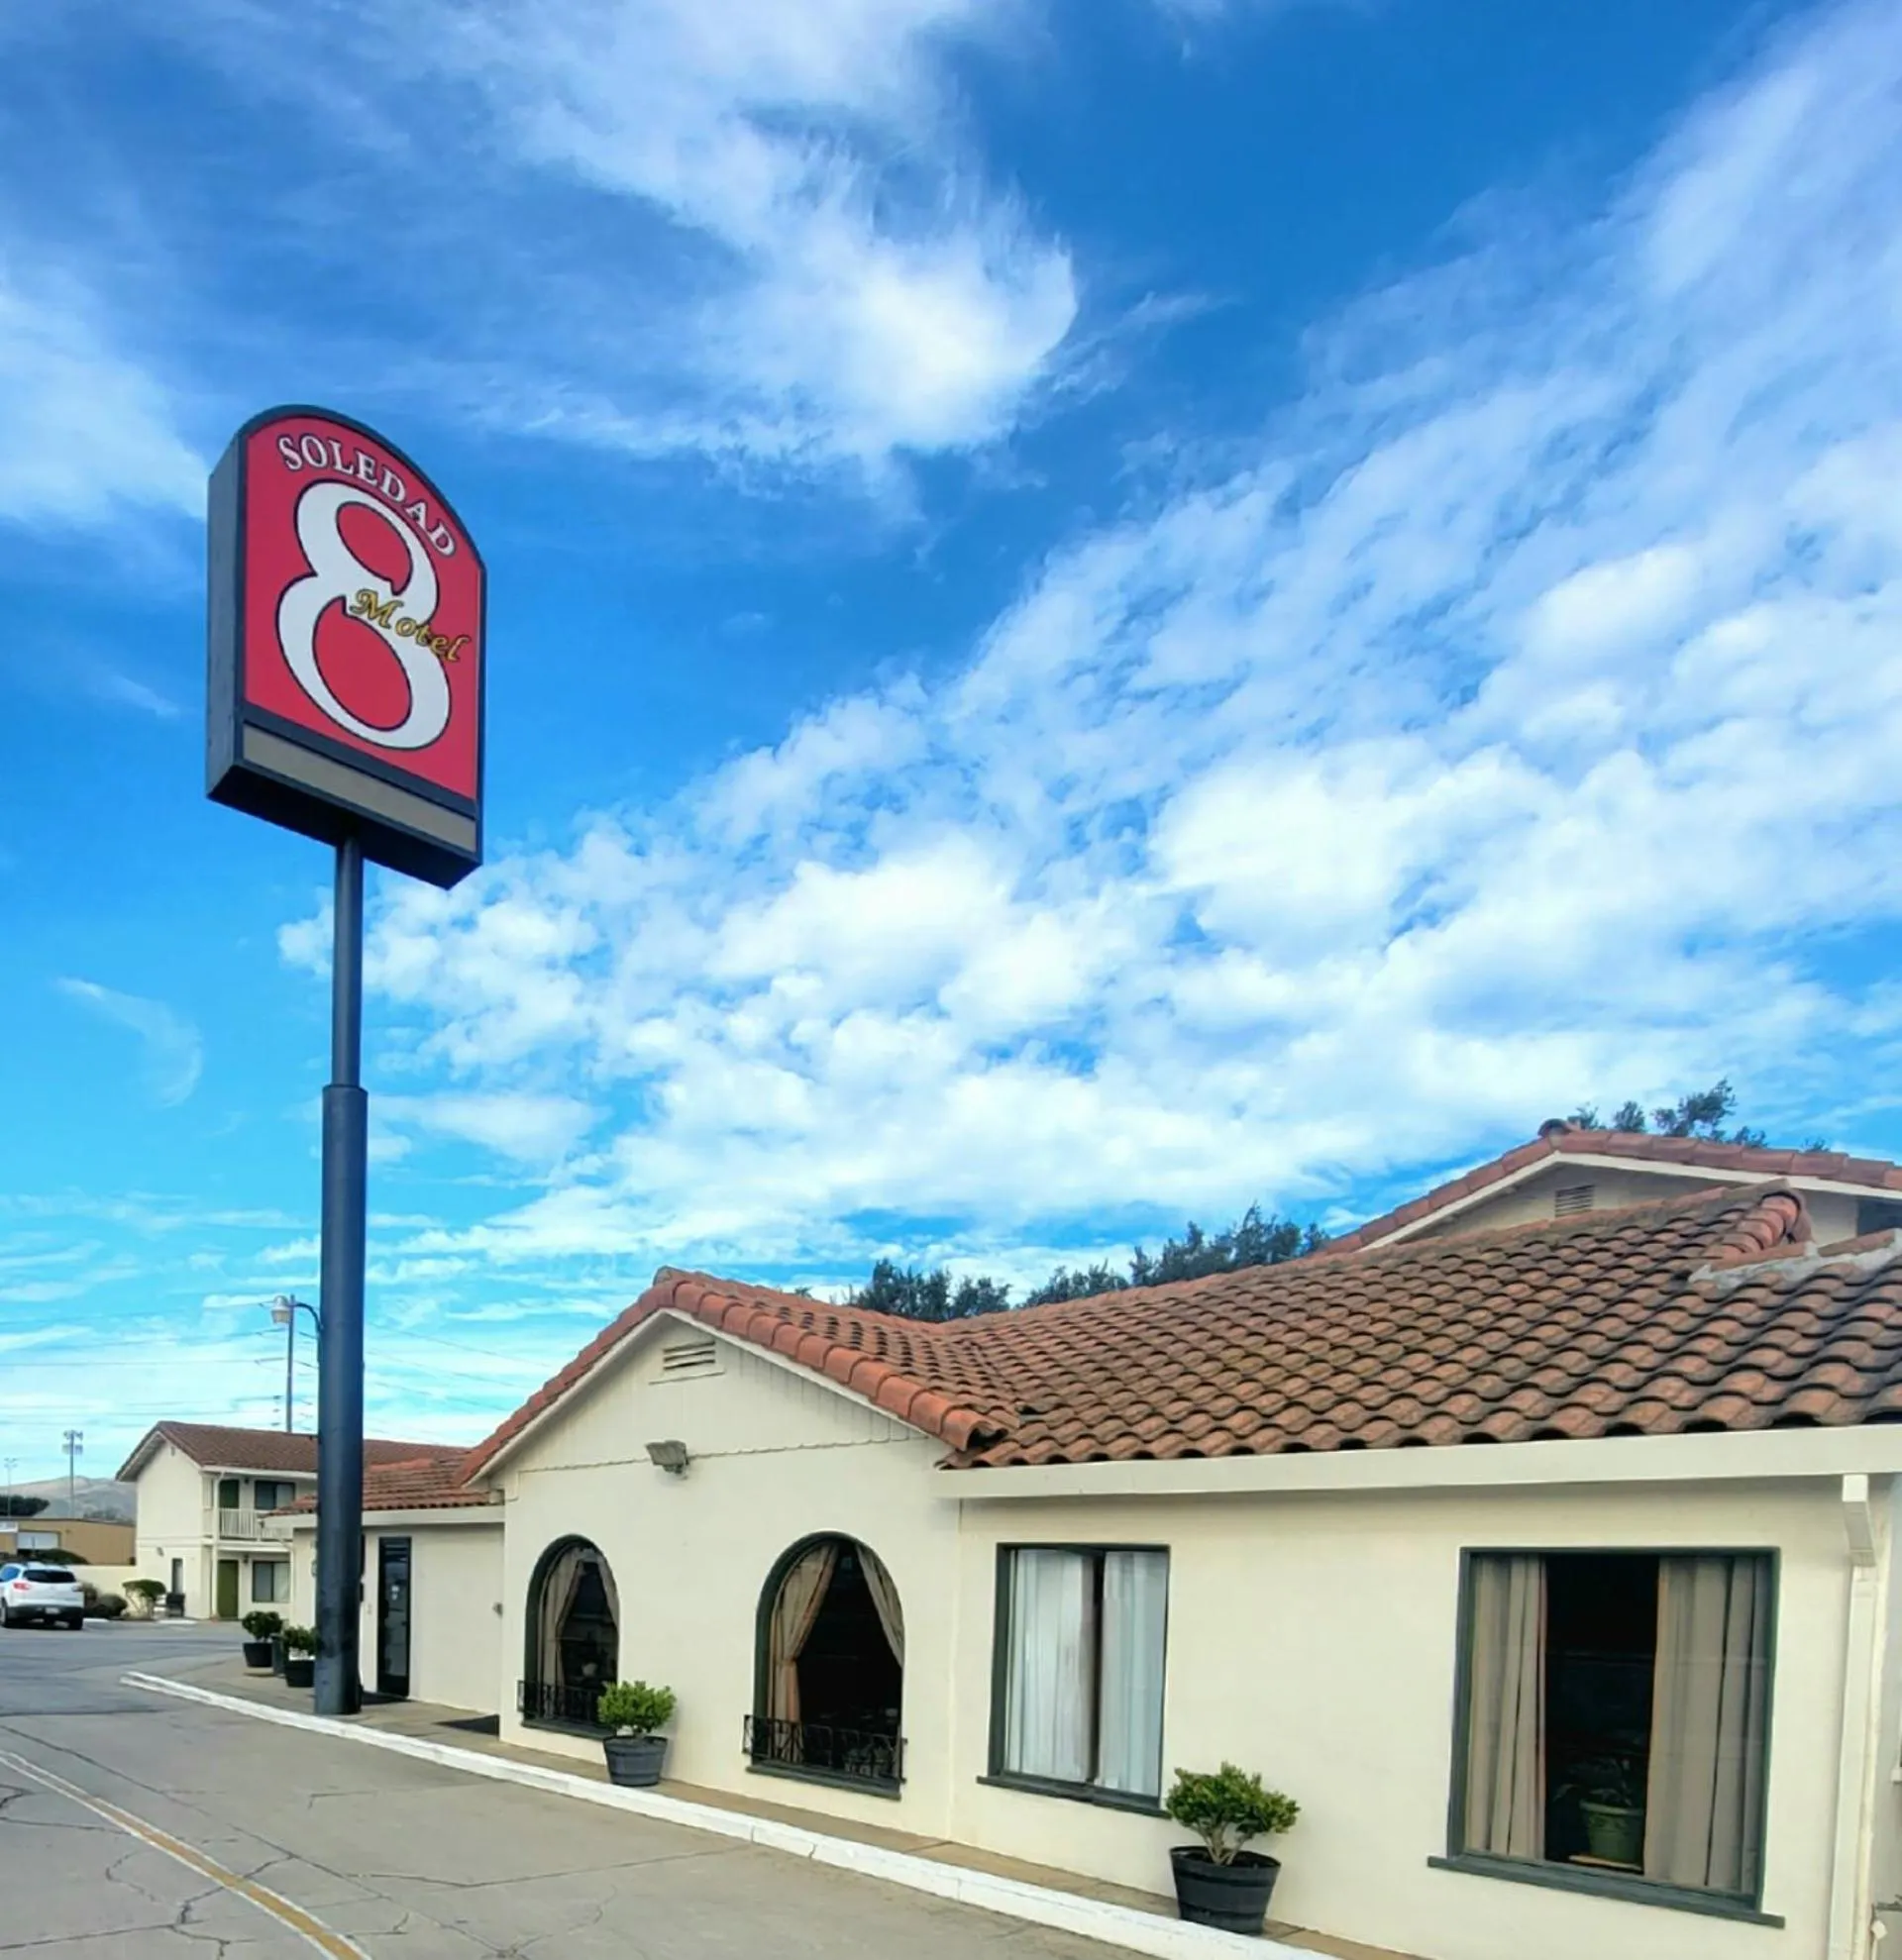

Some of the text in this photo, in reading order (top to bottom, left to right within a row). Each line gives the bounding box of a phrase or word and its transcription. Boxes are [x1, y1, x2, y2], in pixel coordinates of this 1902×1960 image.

[278, 436, 457, 557] SOLEDAD
[276, 480, 452, 751] 8
[349, 588, 471, 661] Motel
